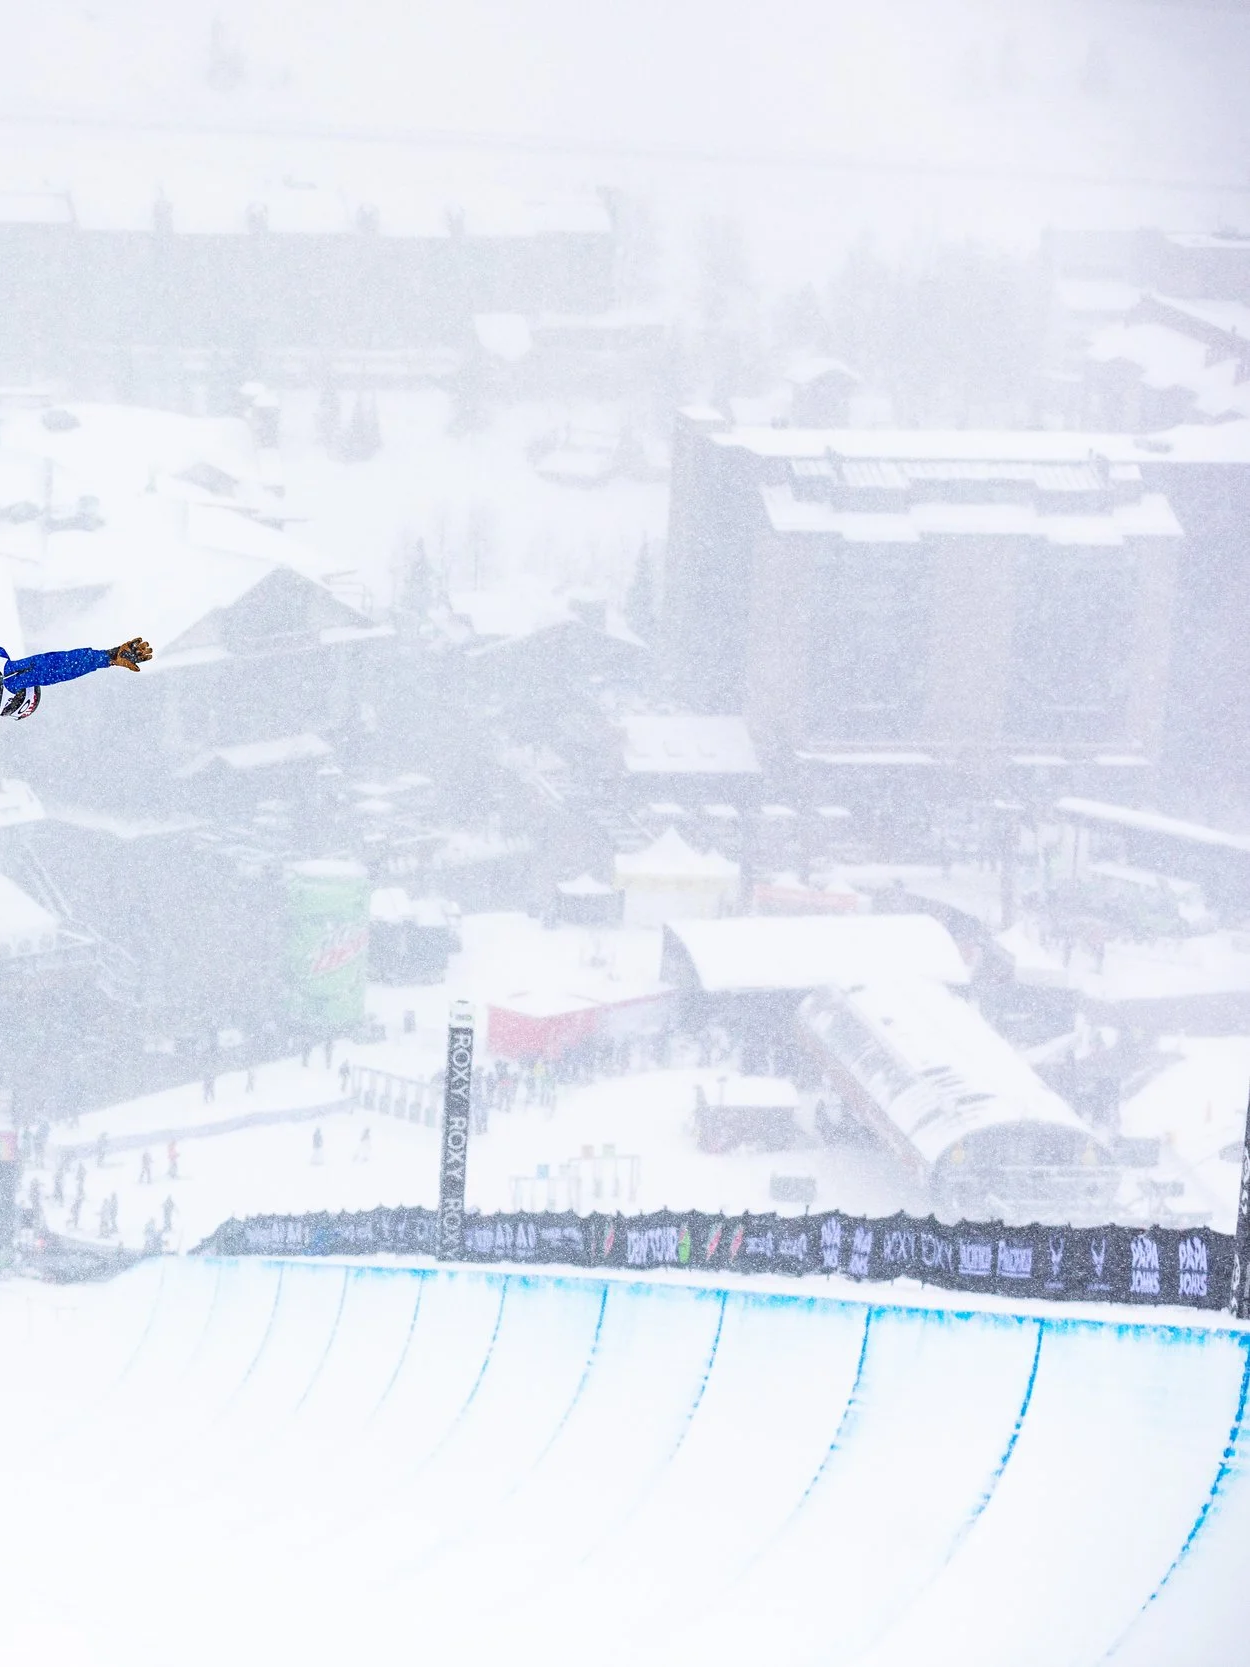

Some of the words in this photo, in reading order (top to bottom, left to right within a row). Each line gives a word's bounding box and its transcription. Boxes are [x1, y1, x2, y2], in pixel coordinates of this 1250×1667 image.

[452, 1034, 471, 1098] ROXY
[447, 1117, 466, 1179] ROXY
[1179, 1236, 1207, 1270] PAPA
